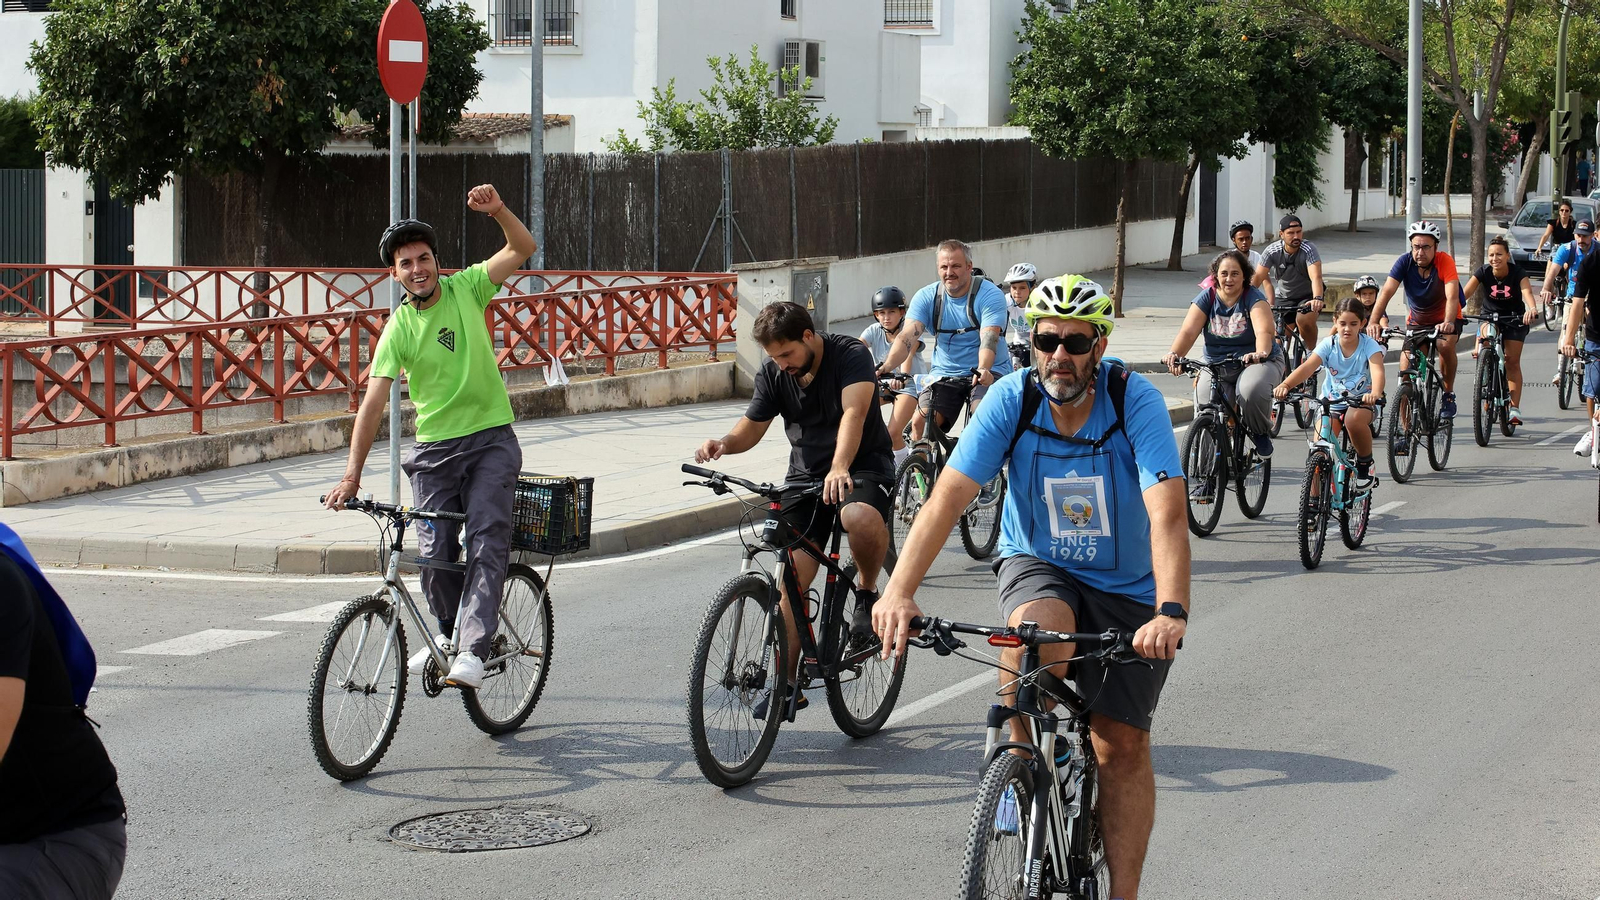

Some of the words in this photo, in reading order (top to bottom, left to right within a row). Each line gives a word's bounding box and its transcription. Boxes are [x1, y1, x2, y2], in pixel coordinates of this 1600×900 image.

[1051, 535, 1097, 546] SINCE
[1050, 546, 1097, 561] 1949
[1029, 859, 1041, 897] ROCKSHOX
